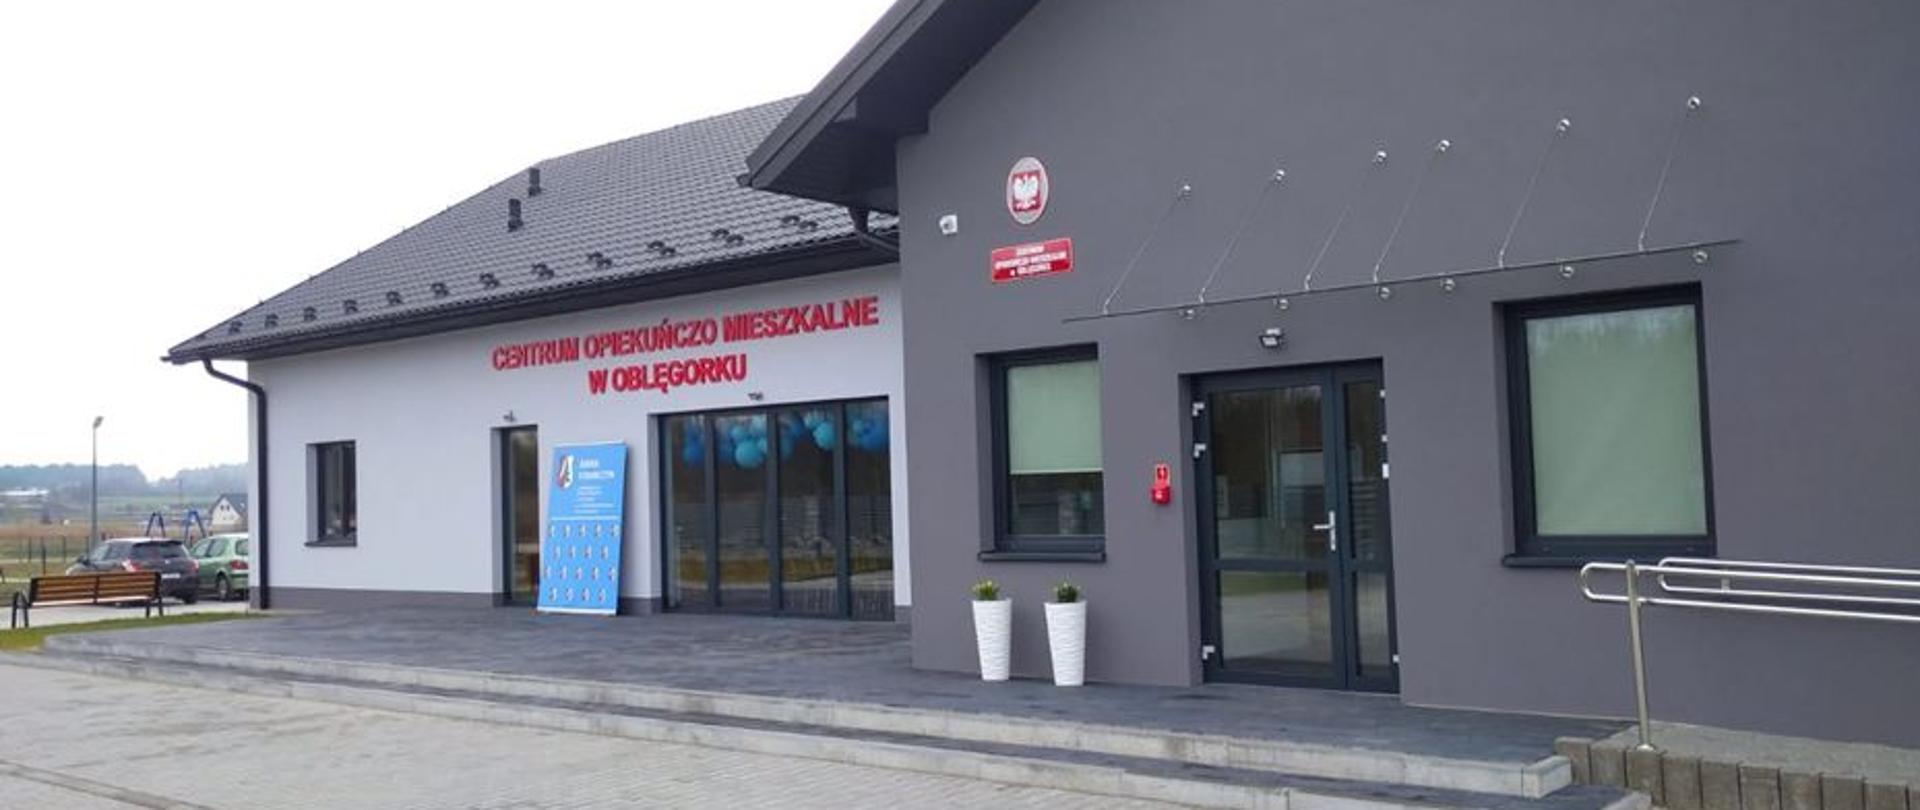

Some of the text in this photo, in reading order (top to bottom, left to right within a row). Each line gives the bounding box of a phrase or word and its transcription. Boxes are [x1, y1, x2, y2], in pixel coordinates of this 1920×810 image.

[492, 295, 880, 371] CENTRUM OPIEKUŃCZO MIESZKALNE
[588, 353, 747, 395] W OBLĘGORKU
